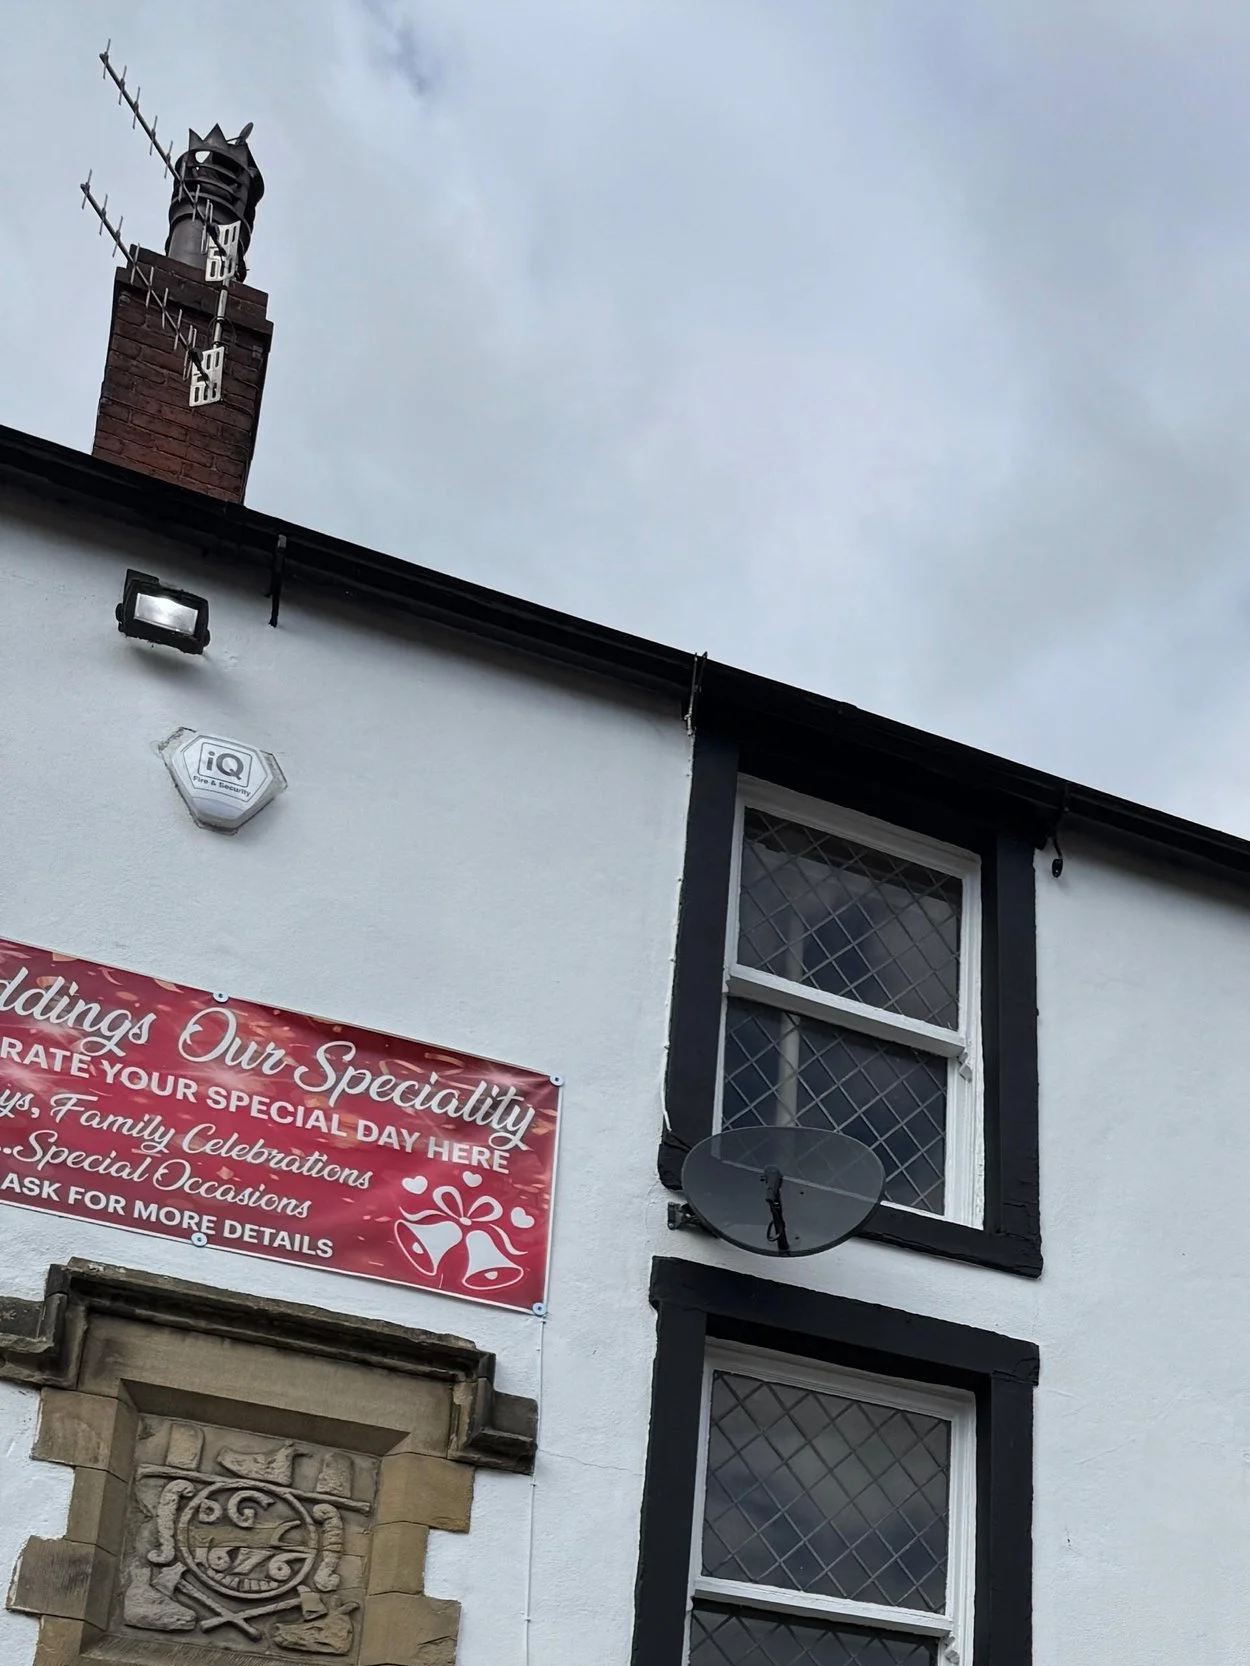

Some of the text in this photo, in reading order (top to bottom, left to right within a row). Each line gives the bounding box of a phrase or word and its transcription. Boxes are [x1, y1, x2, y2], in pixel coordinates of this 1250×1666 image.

[193, 776, 209, 785] Fire
[219, 781, 251, 797] Security
[206, 751, 244, 780] iQ
[0, 1036, 511, 1175] RATE YOUR SPECIAL DAY HERE
[178, 1007, 288, 1075] Our
[293, 1040, 536, 1151] Speciality
[50, 1093, 176, 1153] Family
[182, 1123, 374, 1189] Celebrations
[1, 1172, 334, 1258] ASK FOR MORE DETAILS
[153, 1159, 312, 1218] Occasions
